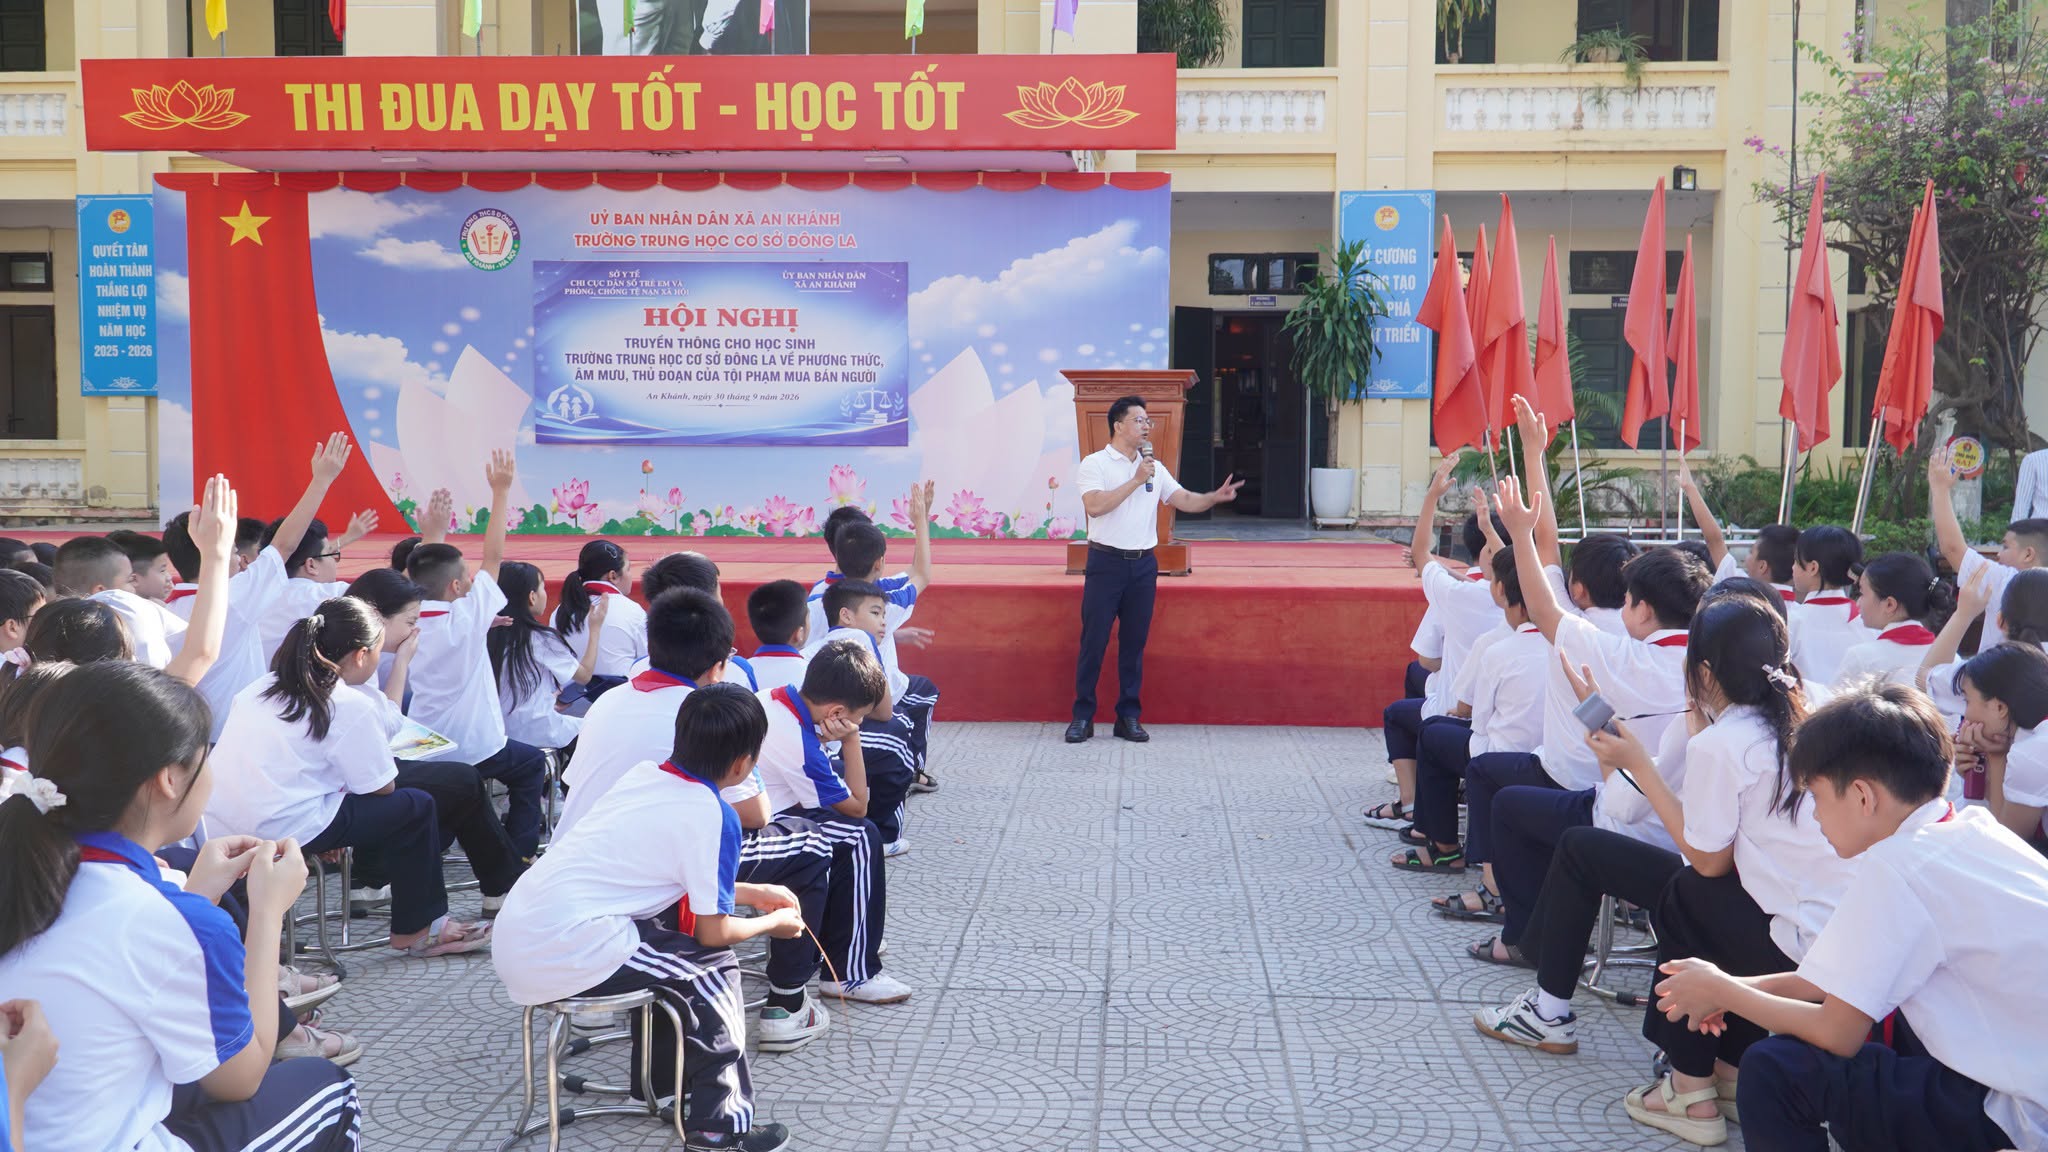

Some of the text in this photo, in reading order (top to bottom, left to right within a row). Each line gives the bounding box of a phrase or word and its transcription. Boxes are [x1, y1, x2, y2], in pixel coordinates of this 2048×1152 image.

[285, 63, 965, 142] THI ĐUA DẠY TỐT - HỌC TỐT
[590, 209, 840, 225] UỶ BAN NHÂN DÂN XÃ AN KHÁNH
[93, 241, 148, 257] QUYẾT TÂM
[575, 231, 857, 250] TRƯỜNG TRUNG HỌC CƠ SỞ ĐÔNG LA
[1375, 247, 1416, 264] CƯƠNG
[89, 263, 152, 277] HOÀN THÀNH
[629, 269, 641, 278] TẾ
[818, 271, 844, 279] NHÂN
[846, 271, 866, 279] DÂN
[96, 281, 147, 299] THẮNG LỢI
[570, 279, 585, 287] CHI
[587, 279, 604, 288] CỤC
[607, 279, 624, 287] DÂN
[626, 278, 638, 287] SỐ
[794, 280, 807, 288] XÃ
[824, 280, 856, 288] KHÁNH
[1393, 275, 1416, 294] TẠO
[98, 303, 147, 320] NHIỆM VỤ
[1387, 298, 1411, 316] PHÁ
[643, 303, 799, 332] HỘI NGHỊ
[99, 322, 146, 339] NĂM HỌC
[1385, 321, 1420, 343] TRIỂN
[94, 345, 118, 357] 2025
[128, 345, 152, 357] 2026
[677, 336, 720, 349] THÔNG
[724, 338, 751, 349] CHO
[755, 338, 781, 351] HỌC
[785, 338, 815, 349] SINH
[565, 352, 612, 365] TRƯỜNG
[616, 353, 656, 365] TRUNG
[659, 354, 683, 367] HỌC
[686, 353, 701, 365] CƠ
[705, 351, 721, 365] SỞ
[724, 352, 758, 365] ĐÔNG
[761, 355, 777, 366] LA
[798, 354, 847, 366] PHƯƠNG
[851, 352, 884, 368] THỨC,
[575, 367, 876, 384] ÂM MƯU, THỦ ĐOẠN CỦA TỘI PHẠM MUA BÁN NGƯỜI
[646, 392, 658, 400] An
[692, 393, 712, 402] ngày
[727, 392, 750, 402] tháng
